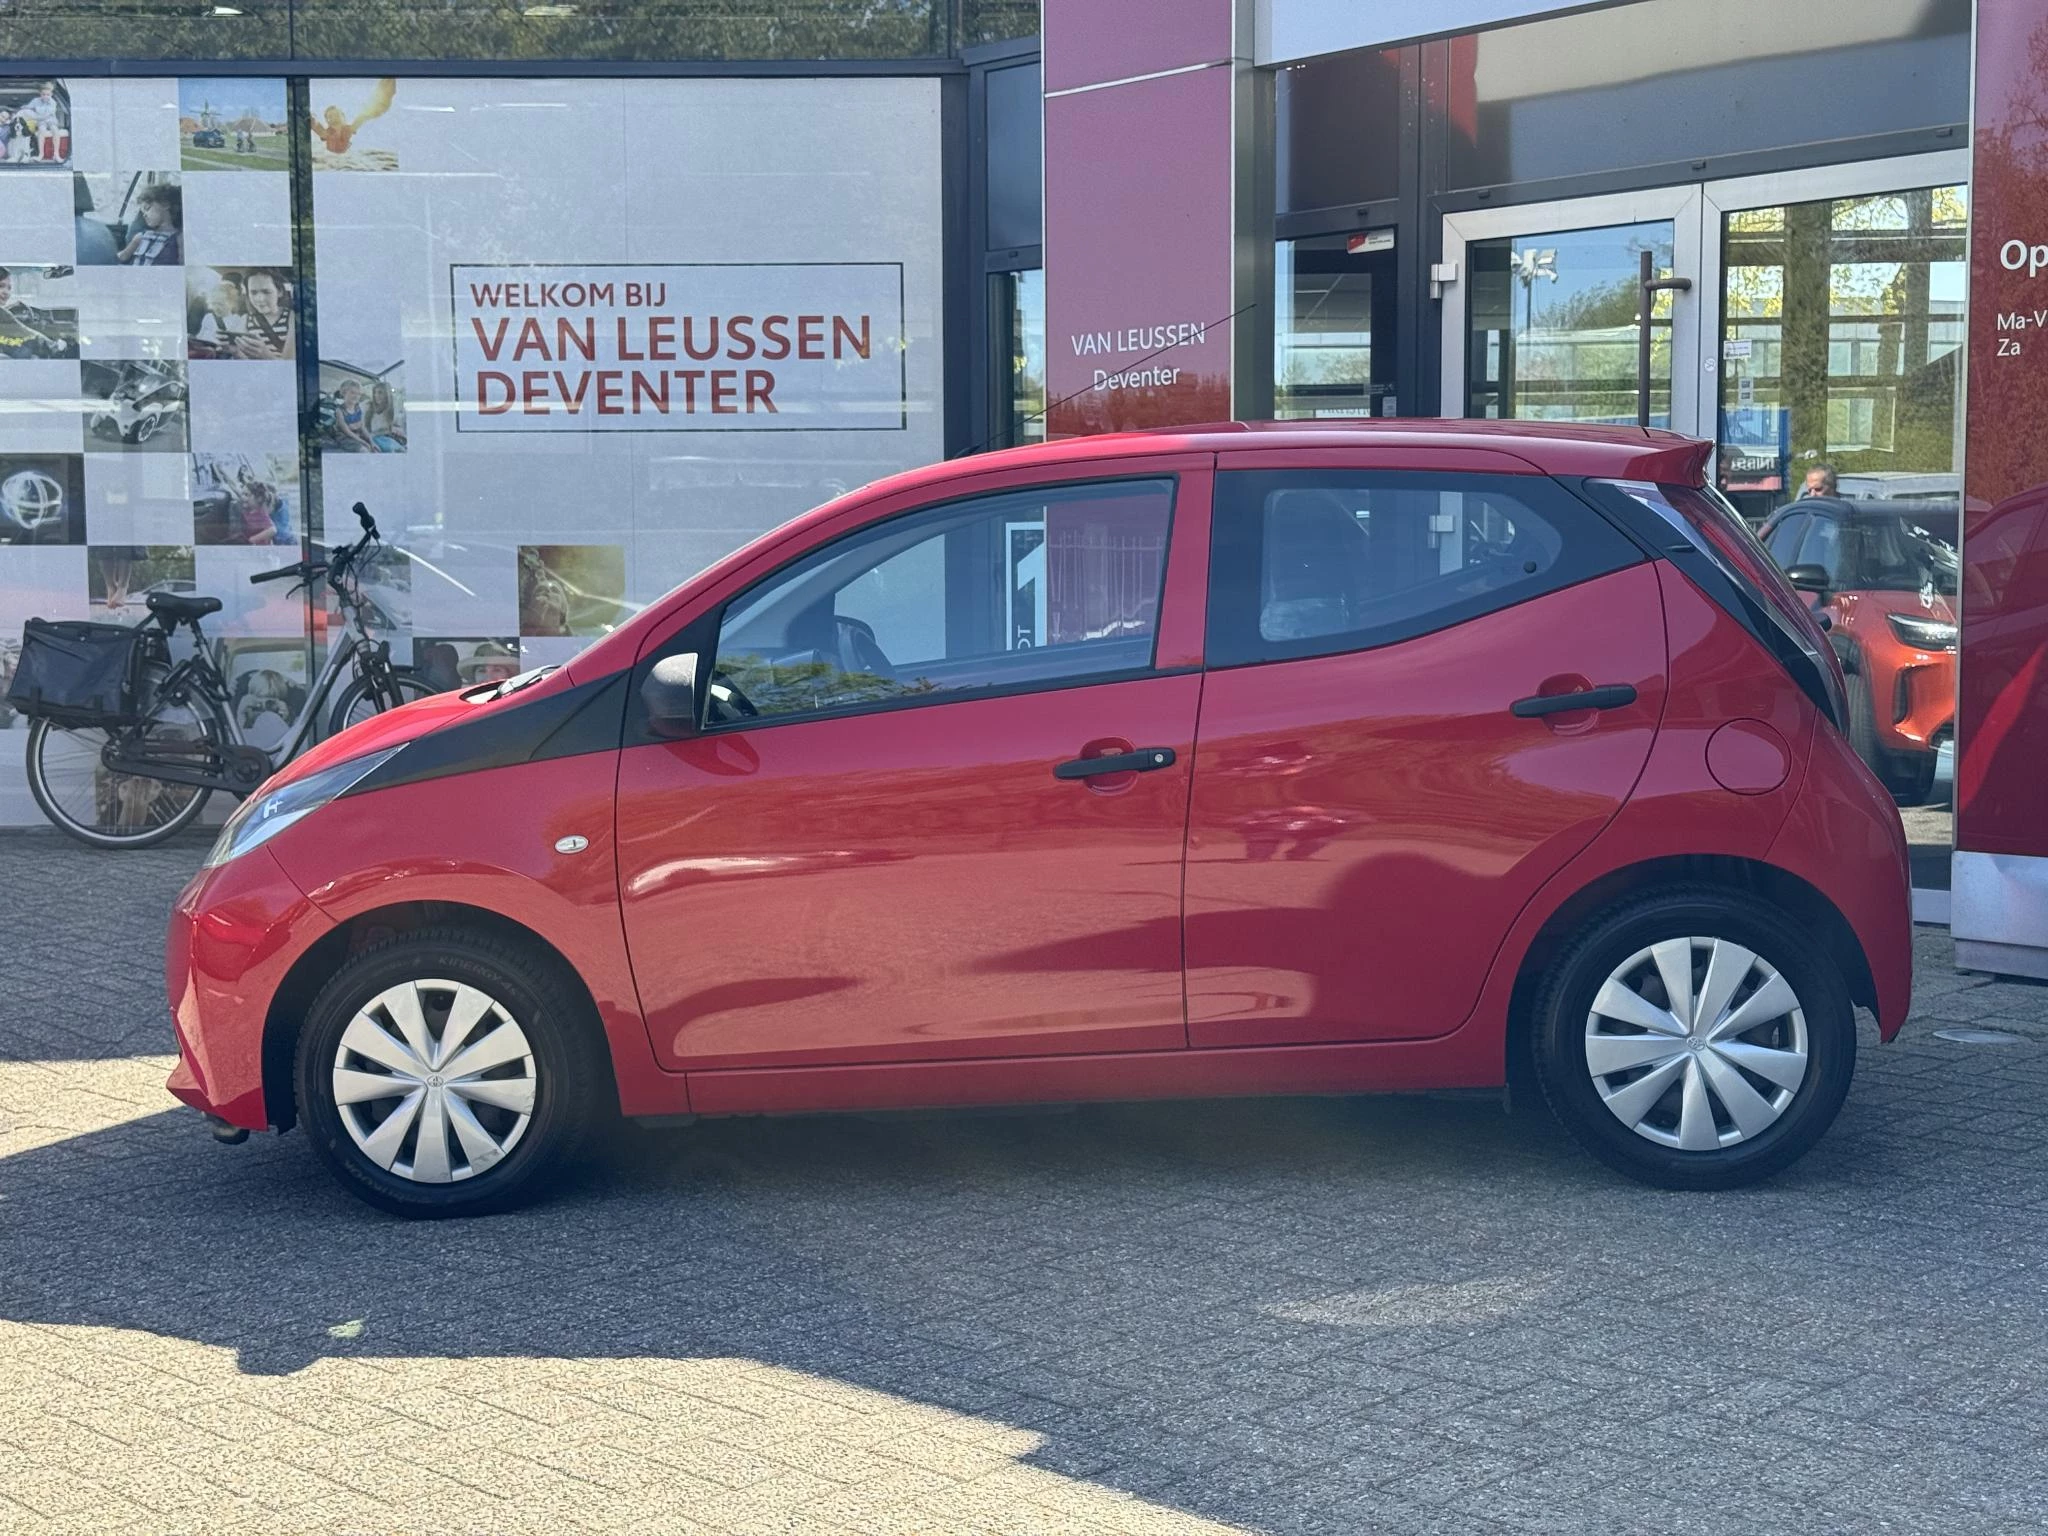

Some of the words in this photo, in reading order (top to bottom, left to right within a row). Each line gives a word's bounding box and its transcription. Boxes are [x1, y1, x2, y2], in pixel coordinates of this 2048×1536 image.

[470, 282, 614, 307] WELKOM
[626, 282, 667, 307] BIJ
[471, 316, 596, 362] VAN
[618, 315, 871, 361] LEUSSEN
[1071, 331, 1111, 357] VAN
[1117, 322, 1206, 353] LEUSSEN
[1996, 338, 2021, 357] Za
[477, 370, 778, 416] DEVENTER
[1093, 365, 1181, 391] Deventer
